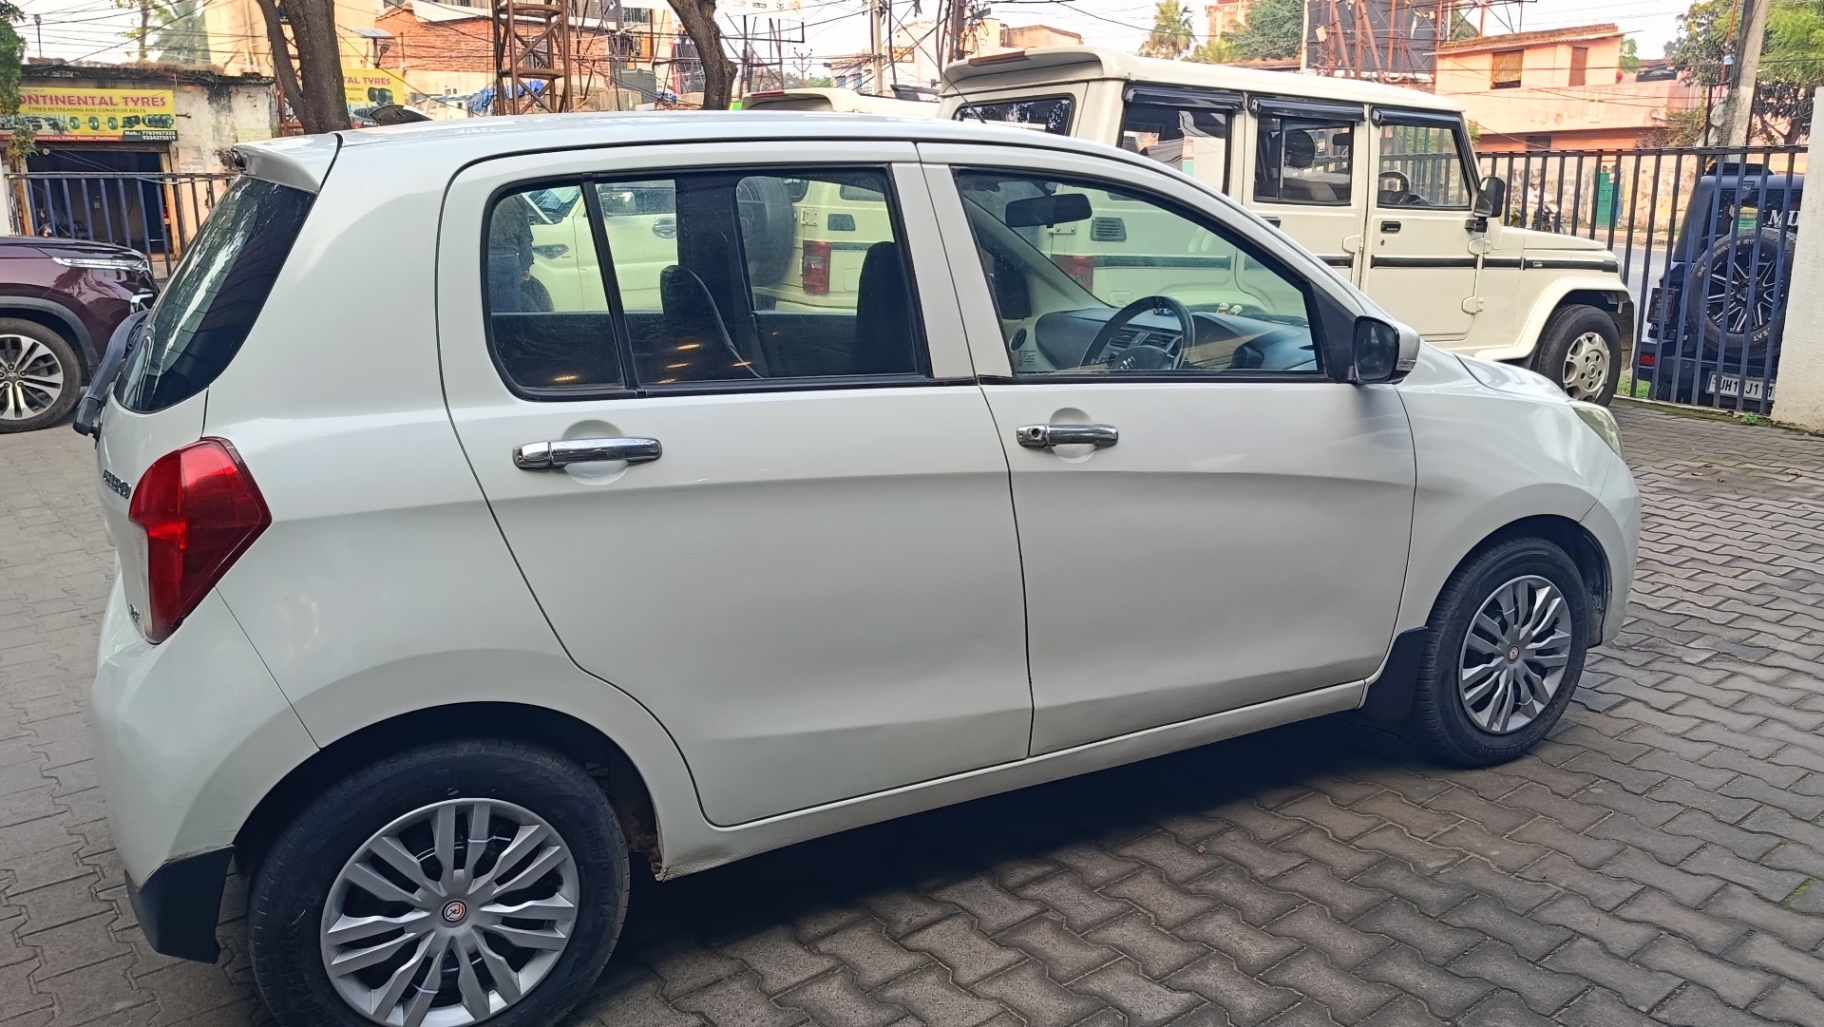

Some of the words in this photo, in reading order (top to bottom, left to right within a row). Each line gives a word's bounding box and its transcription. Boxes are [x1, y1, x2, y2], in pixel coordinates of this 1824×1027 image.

[20, 94, 118, 106] ONTINENTAL
[122, 96, 166, 106] TYRES
[1763, 210, 1799, 229] MU
